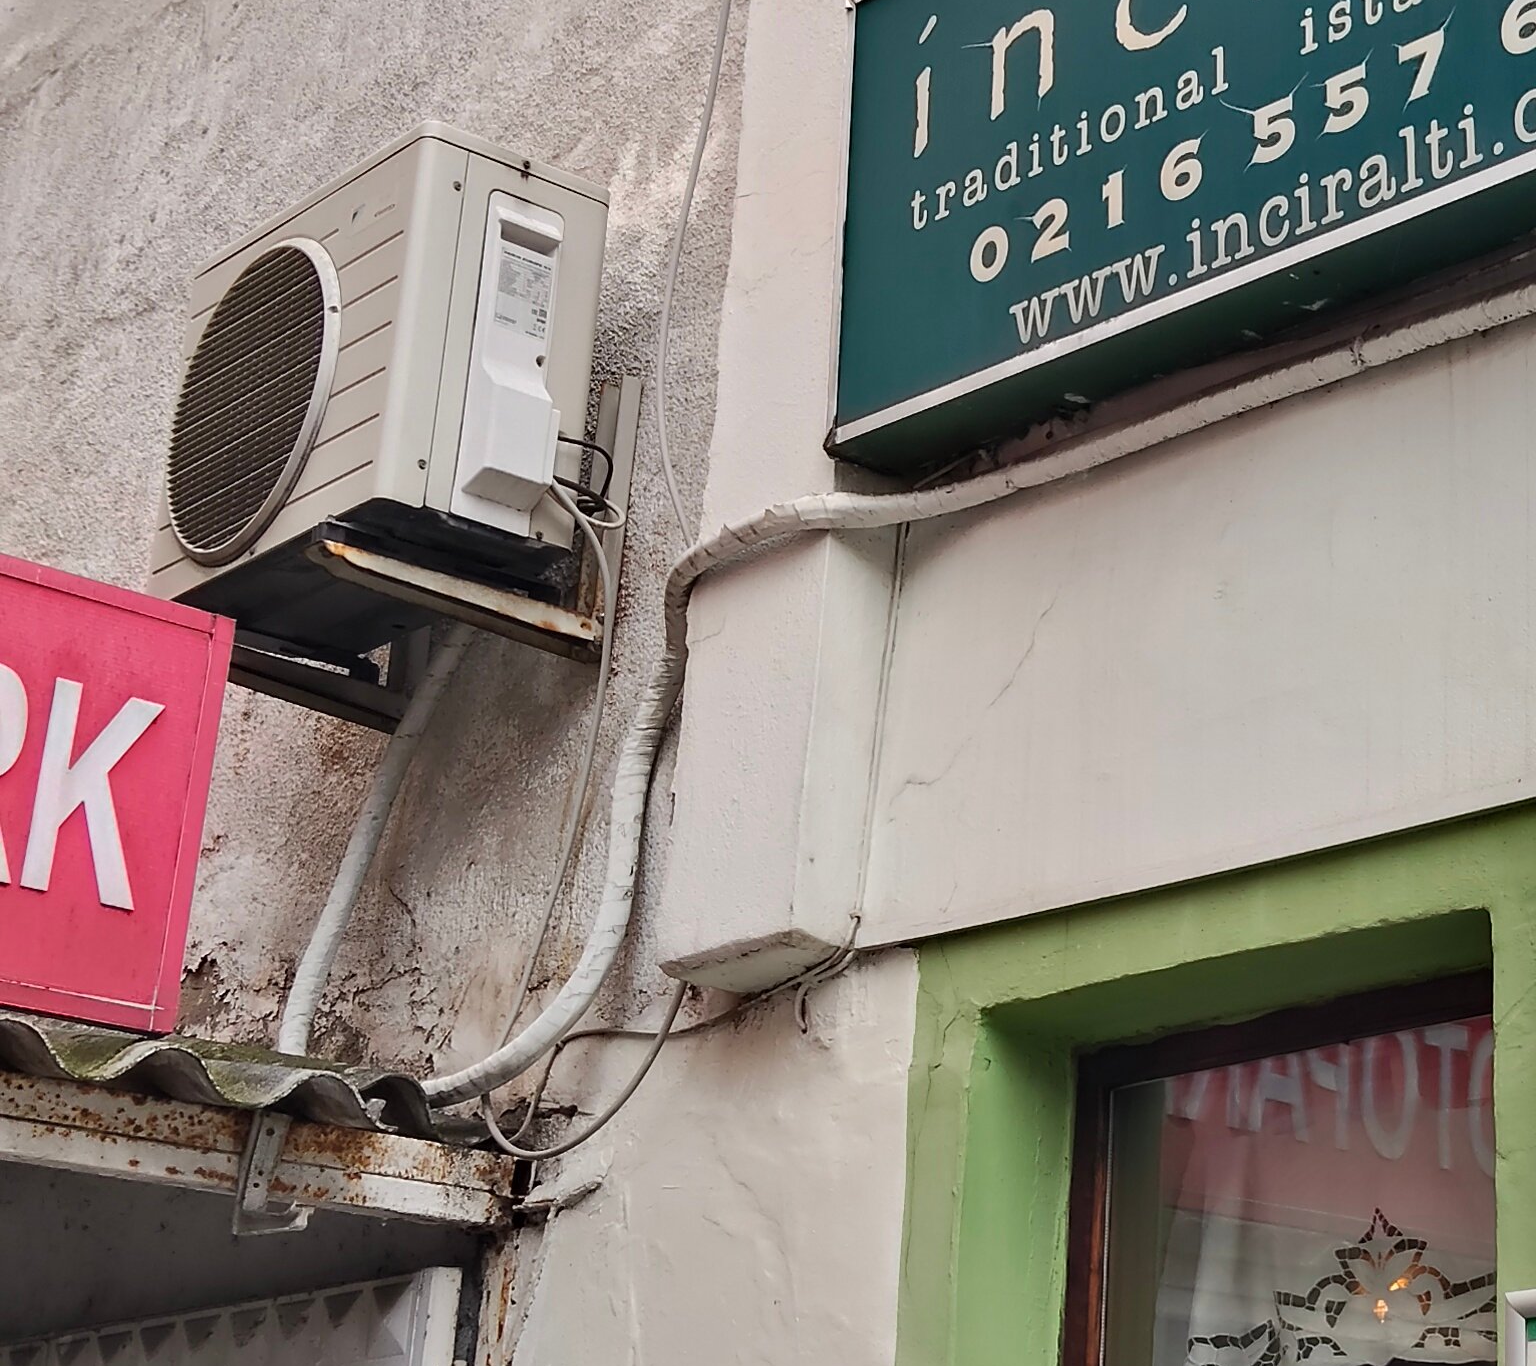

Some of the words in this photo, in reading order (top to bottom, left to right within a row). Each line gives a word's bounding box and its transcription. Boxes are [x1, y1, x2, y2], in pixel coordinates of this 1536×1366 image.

[911, 46, 1229, 230] traditional
[970, 139, 1203, 283] 0216
[1251, 28, 1445, 165] 557
[0, 662, 166, 911] K
